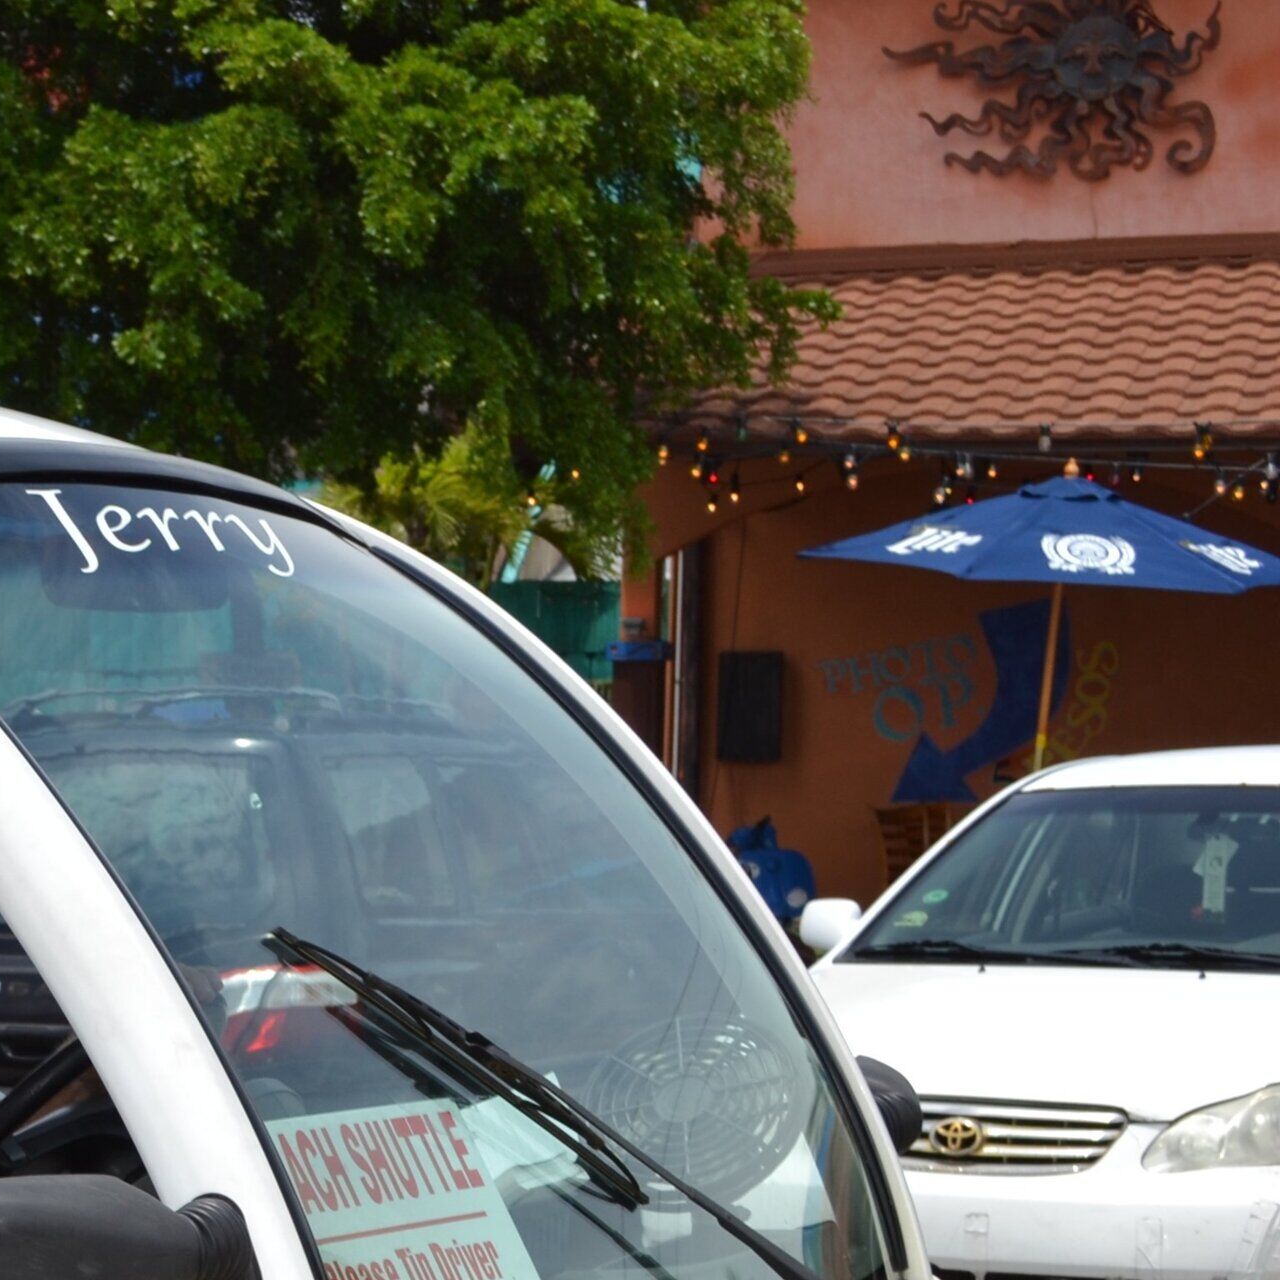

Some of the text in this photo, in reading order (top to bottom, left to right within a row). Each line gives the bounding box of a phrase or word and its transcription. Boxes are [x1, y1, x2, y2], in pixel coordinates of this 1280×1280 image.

[24, 488, 296, 578] Jerry
[817, 632, 979, 695] PHOTO
[278, 1109, 485, 1215] ACH SHUTTLE
